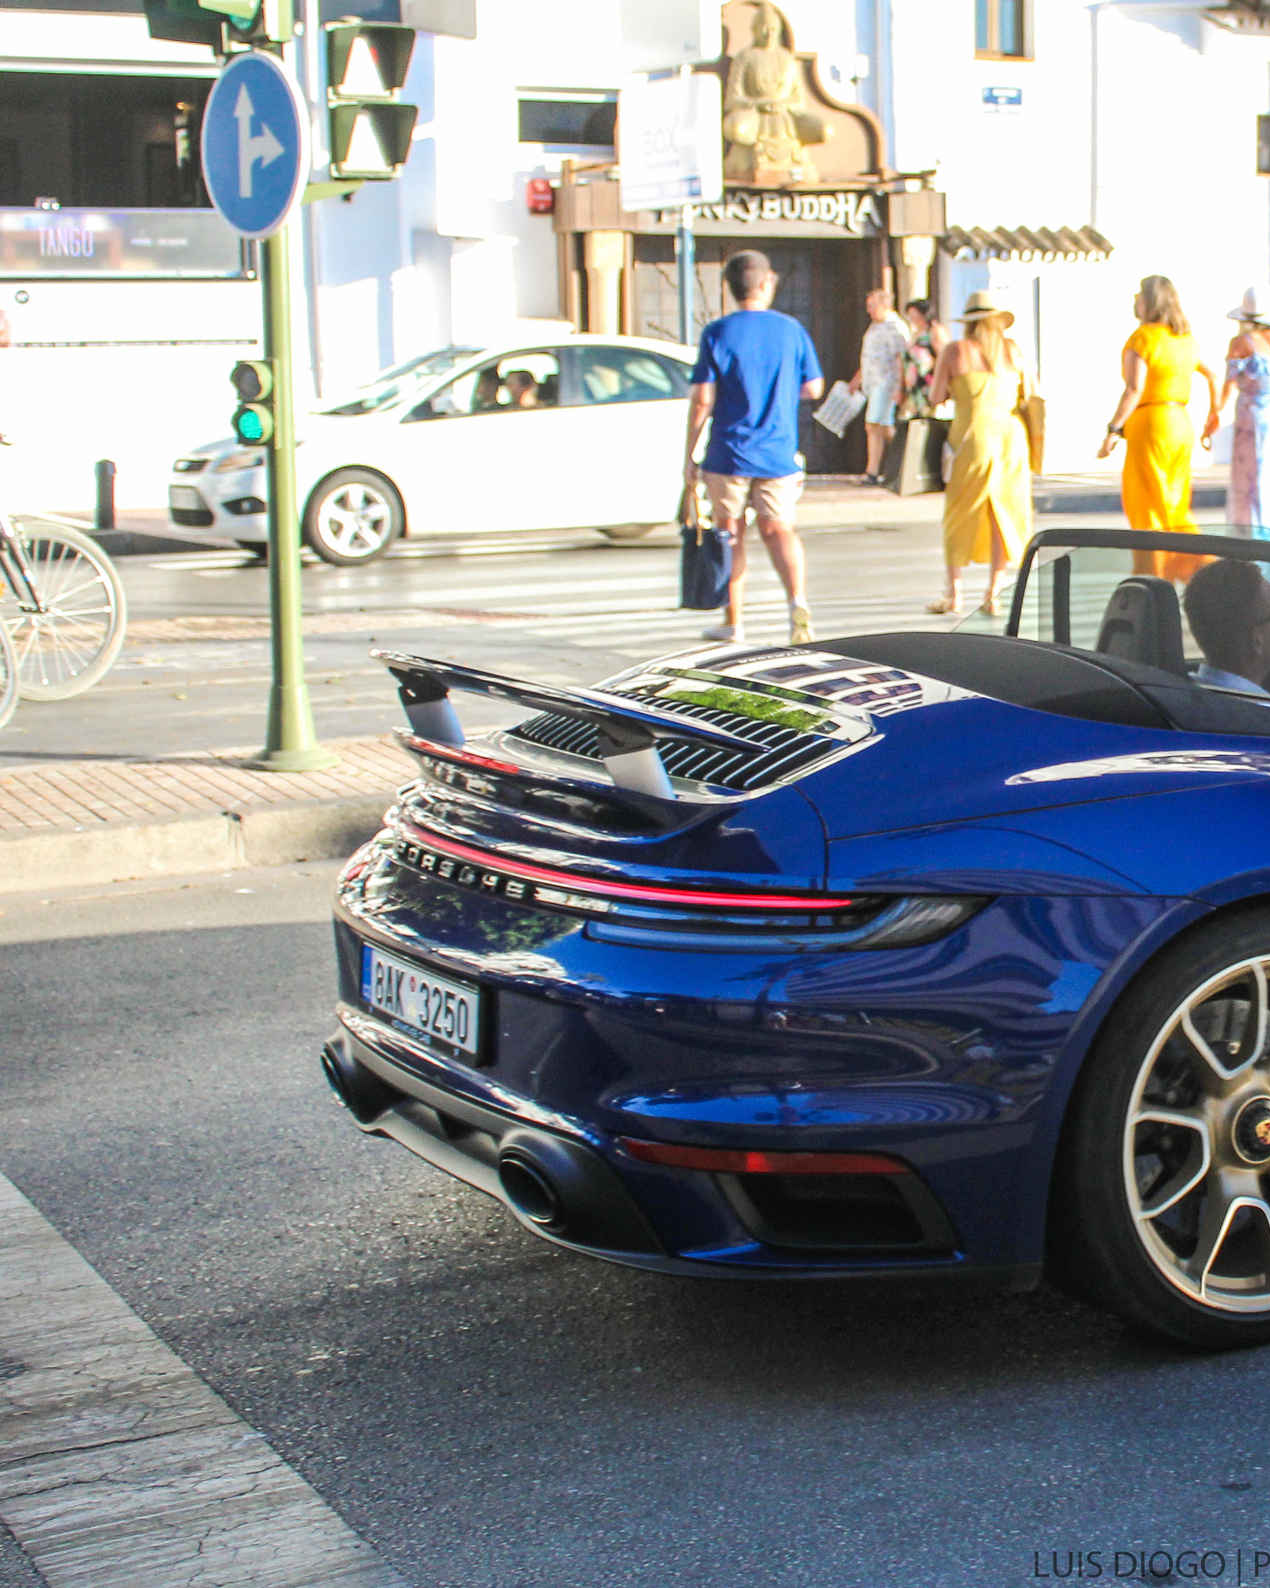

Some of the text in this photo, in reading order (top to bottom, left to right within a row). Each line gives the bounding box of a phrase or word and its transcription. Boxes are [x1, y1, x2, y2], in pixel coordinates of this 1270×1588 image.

[762, 192, 882, 234] BUDDHA
[38, 226, 95, 257] TANGO
[396, 840, 526, 899] PORSCHE
[419, 980, 469, 1045] 3250
